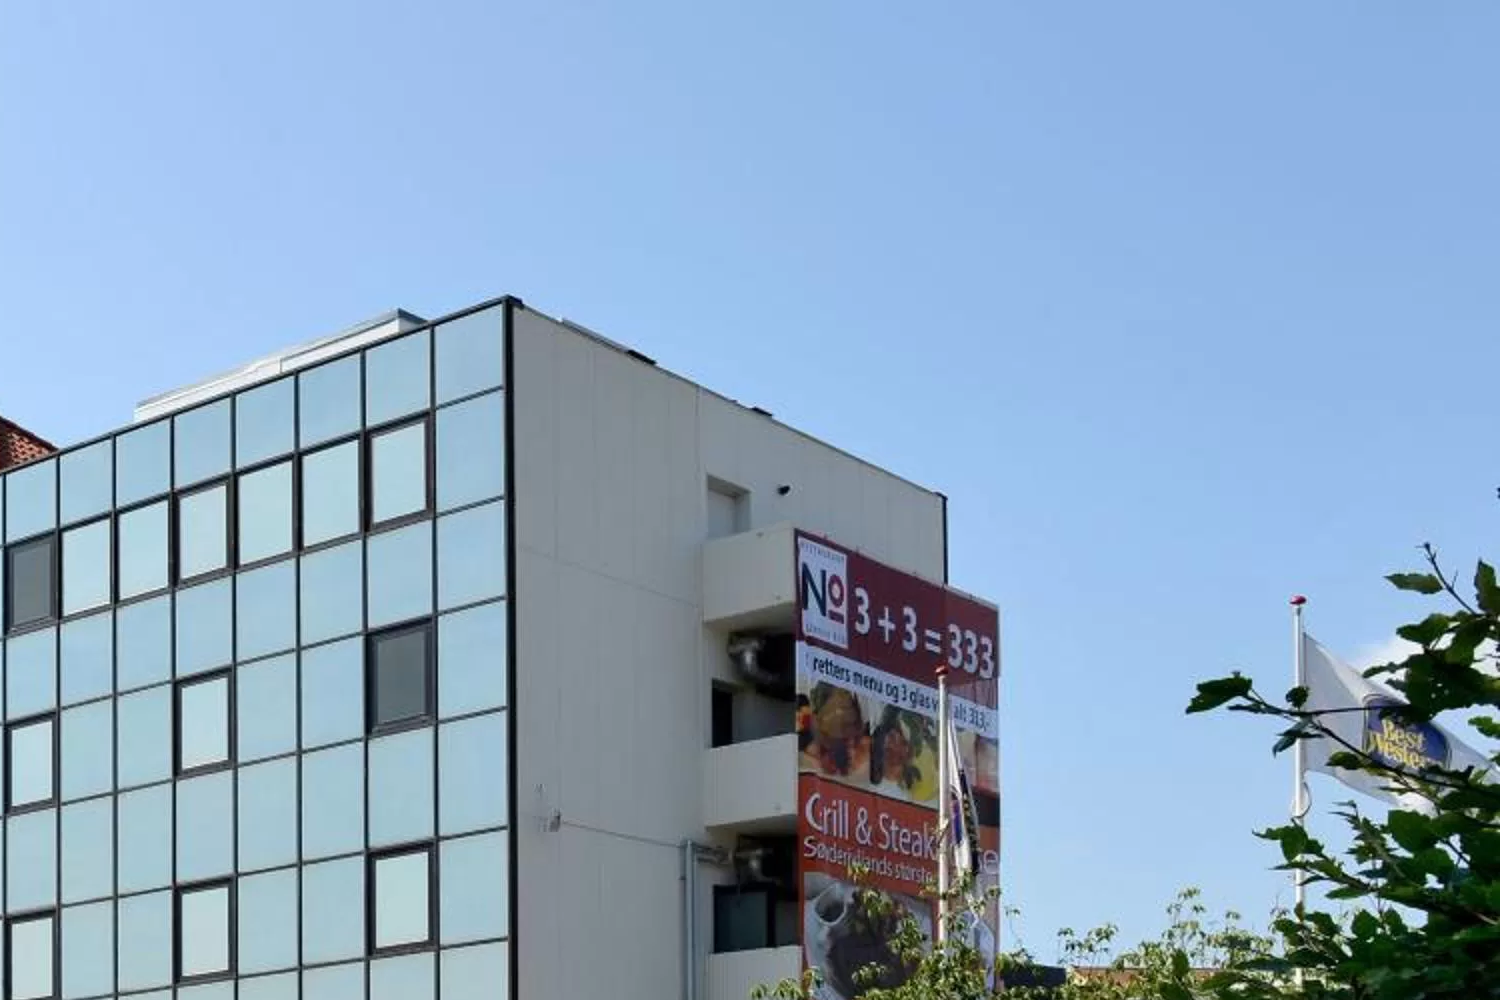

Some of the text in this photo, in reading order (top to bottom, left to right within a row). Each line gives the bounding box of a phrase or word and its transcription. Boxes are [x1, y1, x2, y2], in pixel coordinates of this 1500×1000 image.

[855, 587, 871, 635] 3
[878, 606, 896, 644] +
[903, 605, 917, 652] 3
[924, 628, 941, 655] =
[948, 623, 995, 680] 333
[813, 656, 850, 683] retters
[853, 671, 883, 694] menu
[886, 682, 899, 703] og
[909, 687, 932, 708] glas
[1368, 731, 1443, 769] Weste
[805, 792, 848, 840] Grill
[856, 807, 872, 847] &
